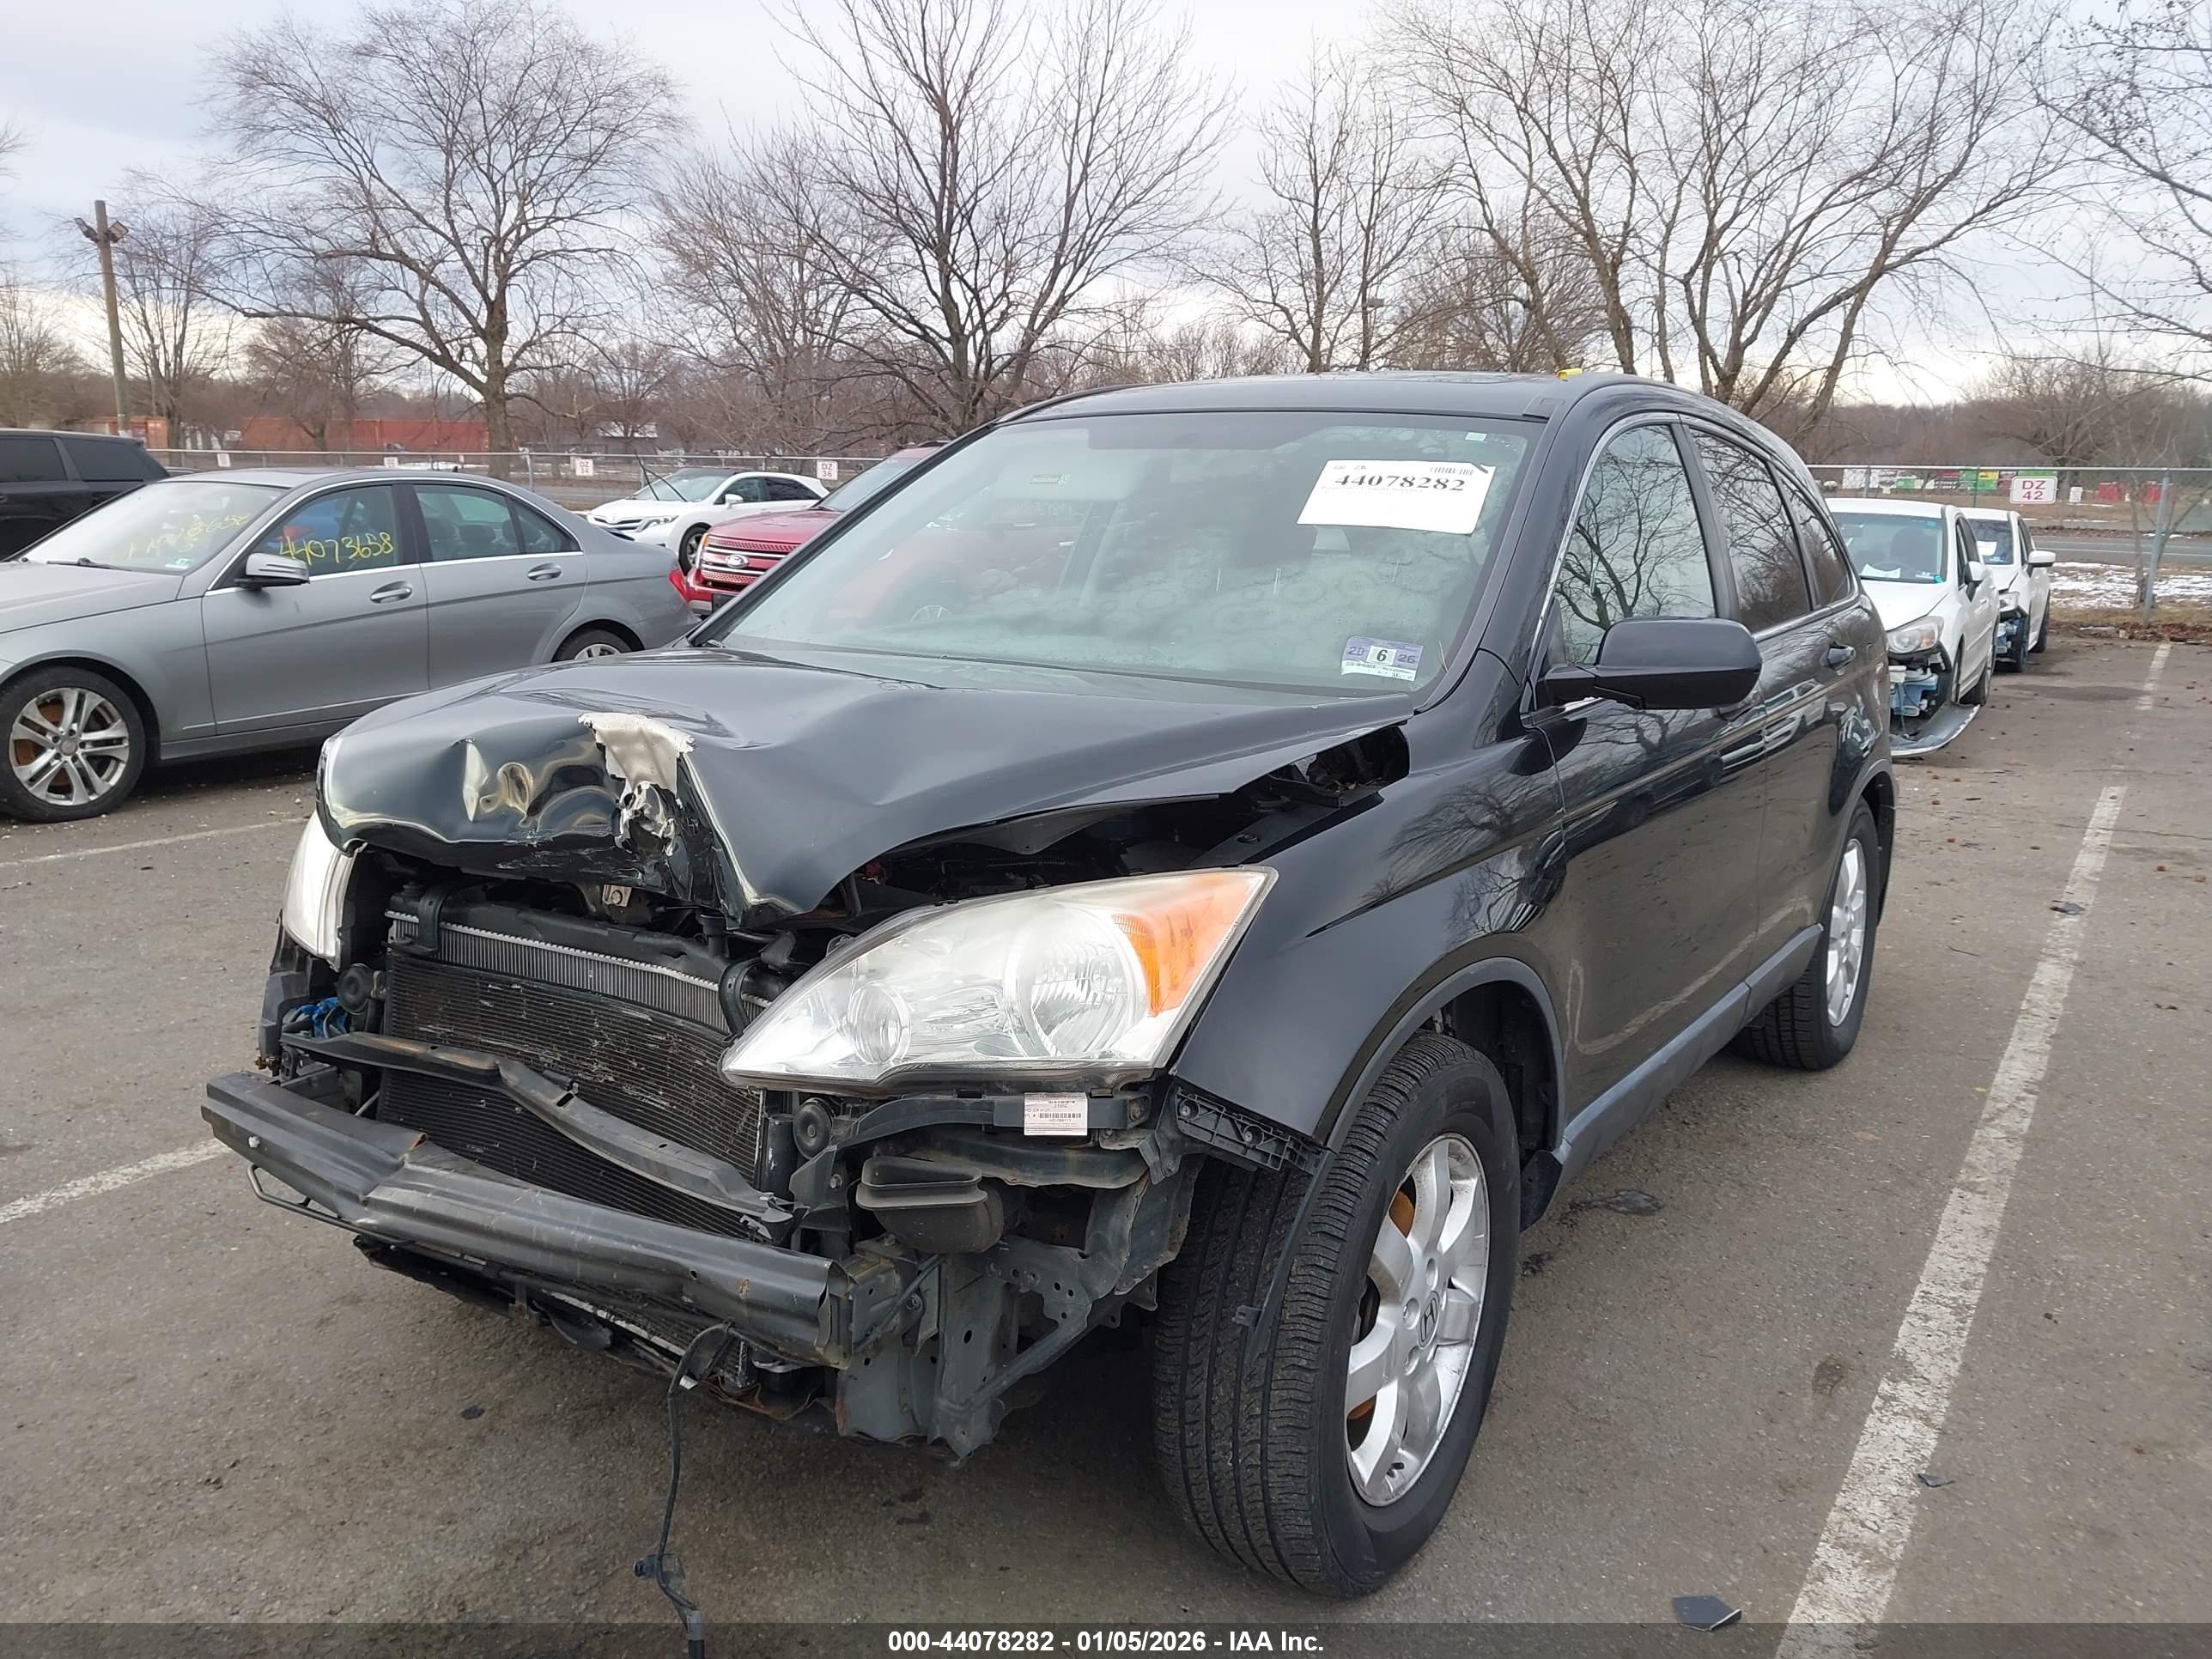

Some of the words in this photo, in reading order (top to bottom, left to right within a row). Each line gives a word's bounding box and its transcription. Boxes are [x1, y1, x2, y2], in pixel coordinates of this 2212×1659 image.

[1334, 474, 1466, 492] 44078282
[2021, 480, 2047, 489] DZ
[2021, 490, 2044, 500] 42
[279, 532, 393, 566] 44073658
[1376, 649, 1388, 662] 6
[1397, 653, 1416, 664] 26
